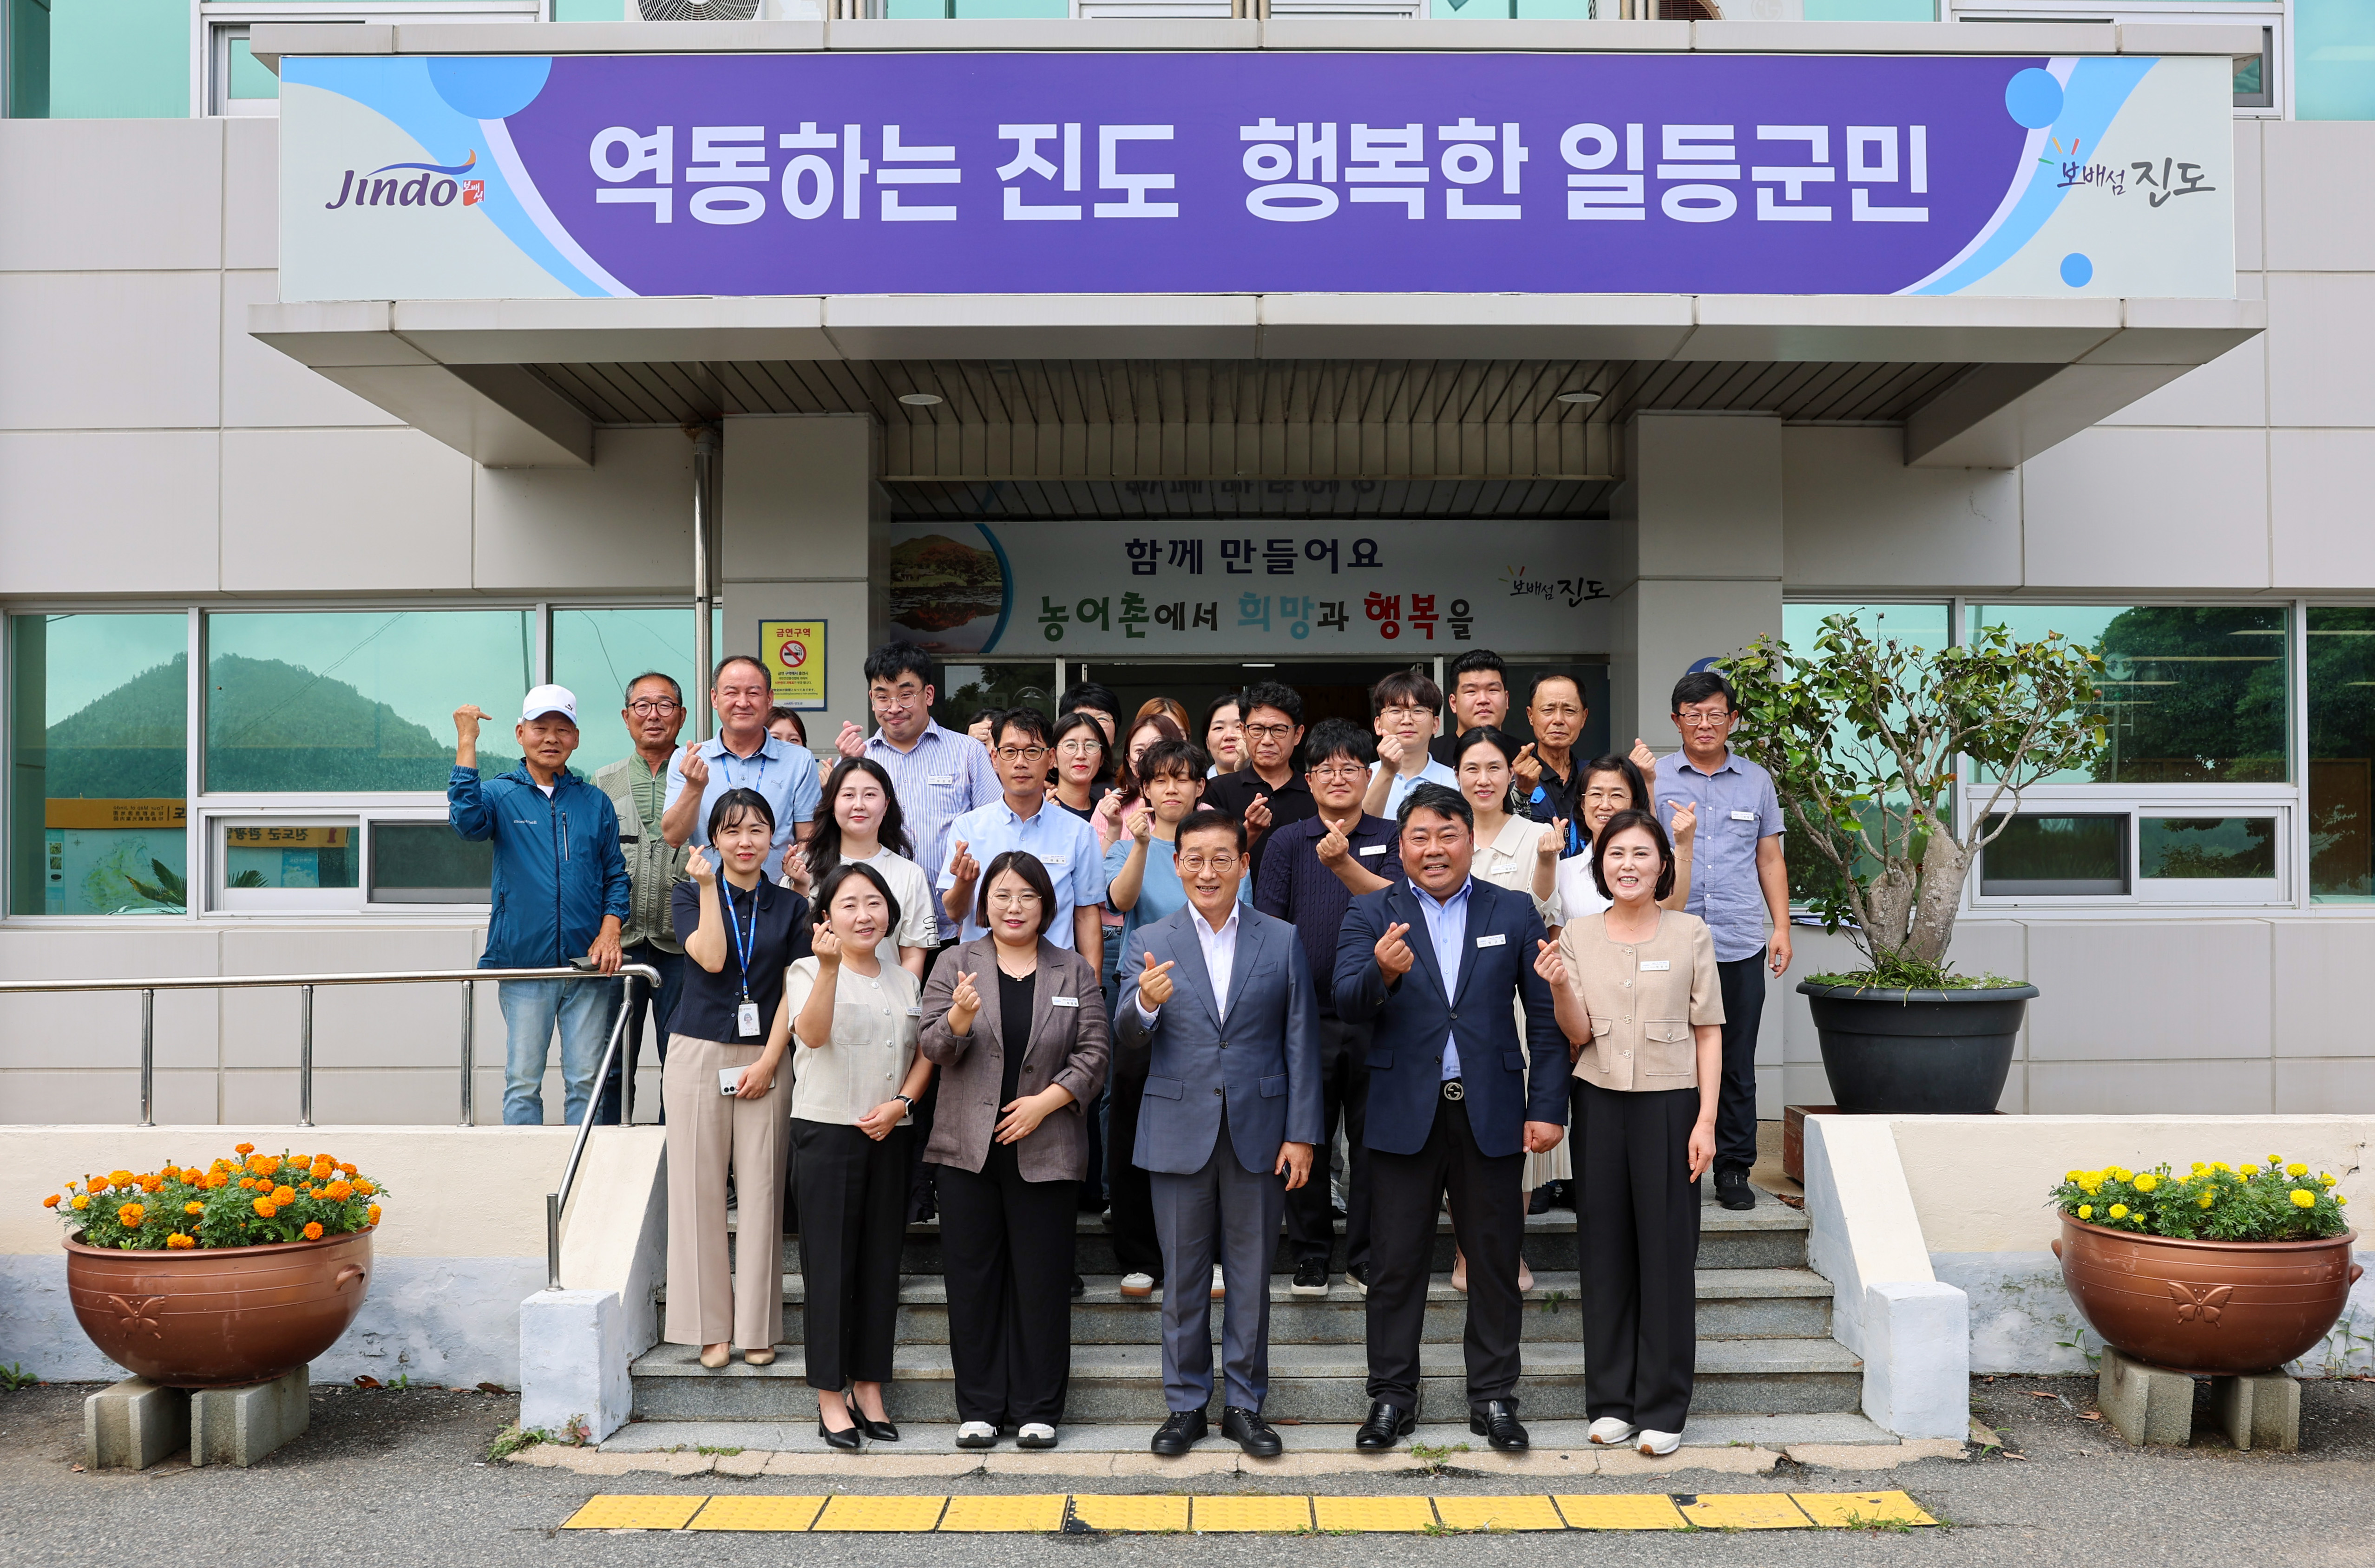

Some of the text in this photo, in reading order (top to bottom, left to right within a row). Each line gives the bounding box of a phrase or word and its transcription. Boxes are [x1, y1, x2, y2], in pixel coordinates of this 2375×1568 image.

[325, 170, 458, 209] Jindo
[590, 118, 1929, 225] 역동하는 진도 행복한 일등군민
[2057, 157, 2216, 208] 보배섬 진도
[1125, 538, 1383, 575] 함께 만들어요
[1510, 577, 1611, 608] 보배섬 진도
[776, 628, 811, 637] 금연구역
[1038, 591, 1474, 642] 농어촌에서 희망과 행복을
